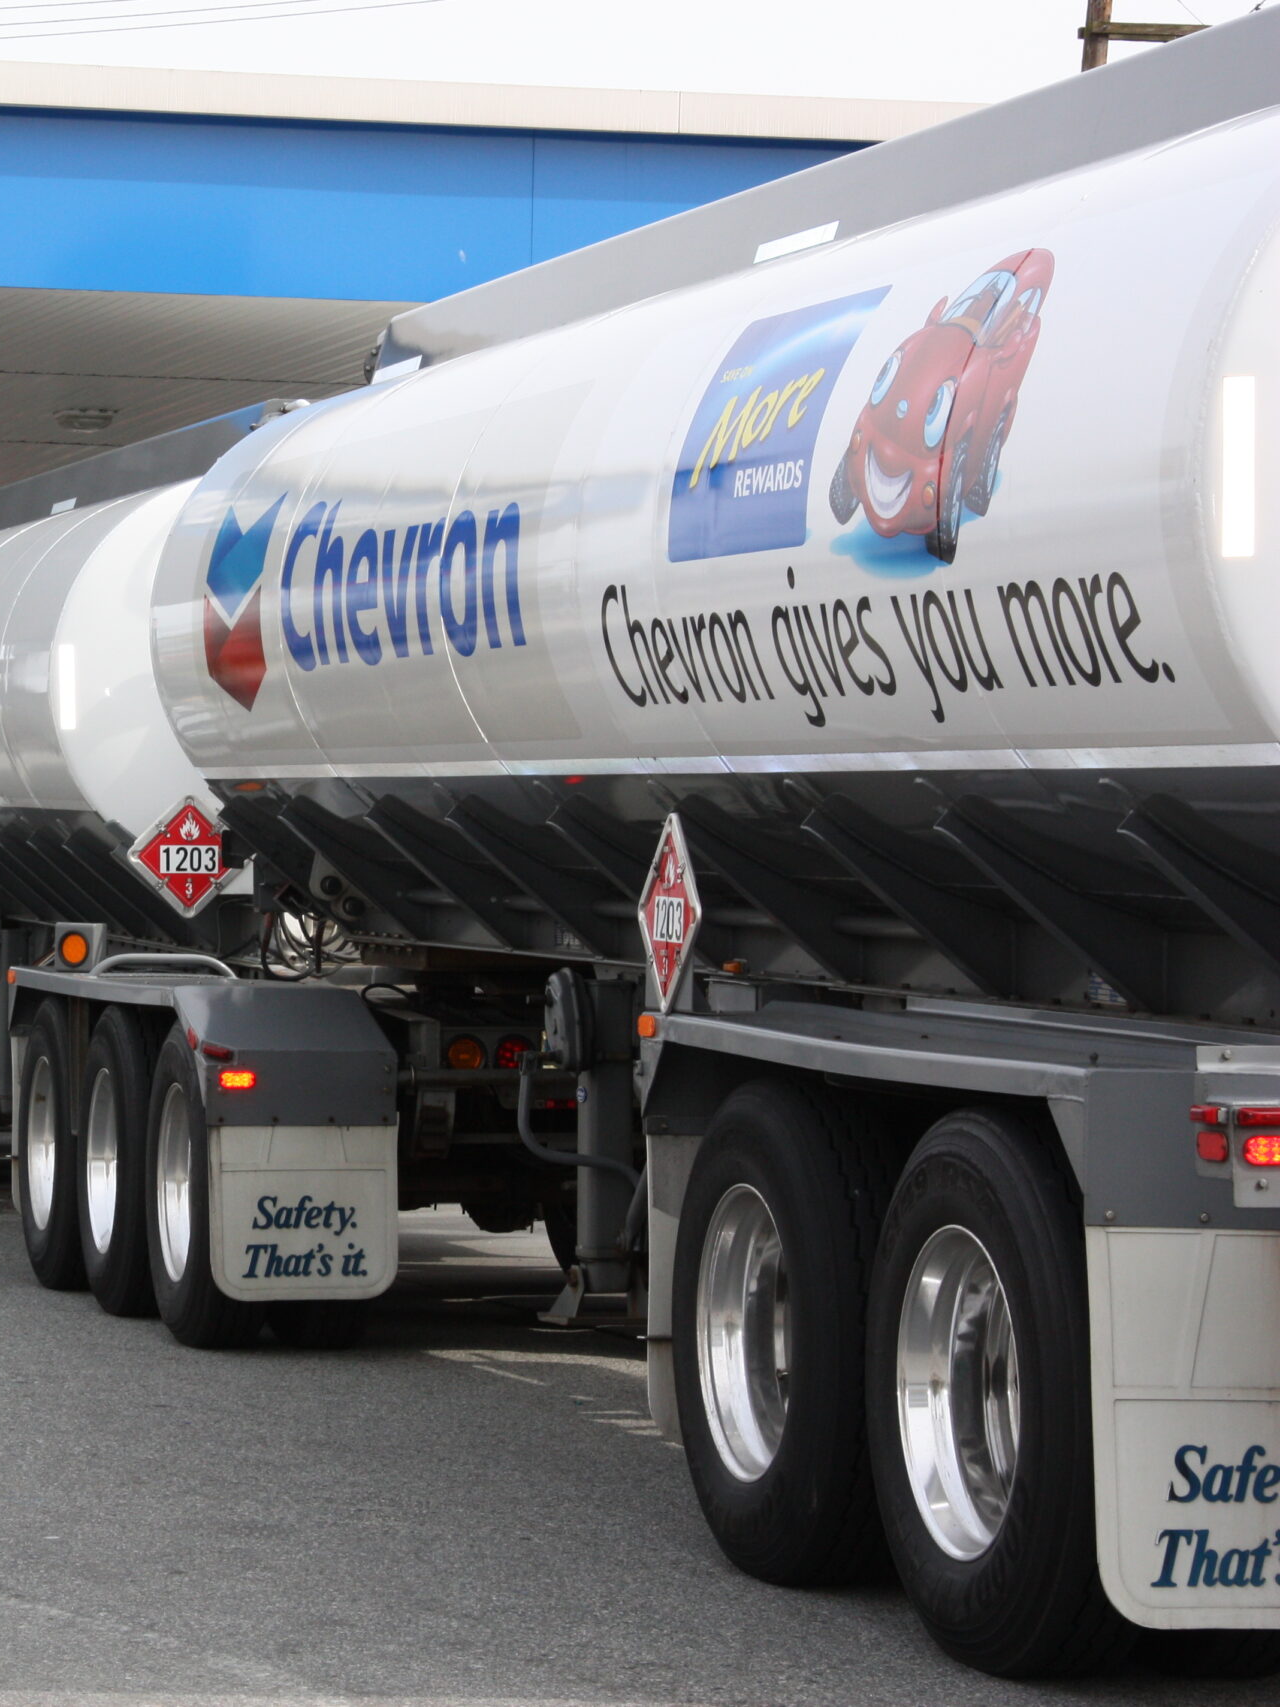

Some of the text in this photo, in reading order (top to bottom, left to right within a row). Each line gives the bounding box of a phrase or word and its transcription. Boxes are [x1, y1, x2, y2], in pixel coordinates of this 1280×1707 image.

[689, 367, 825, 488] More
[734, 459, 804, 498] REWARDS
[281, 497, 527, 672] Chevron
[601, 565, 1176, 727] Chevron gives you more.
[162, 847, 216, 872] 1203
[185, 883, 193, 895] 3
[655, 899, 682, 941] 1203
[252, 1195, 358, 1235] Safety.
[243, 1242, 369, 1279] That's it.
